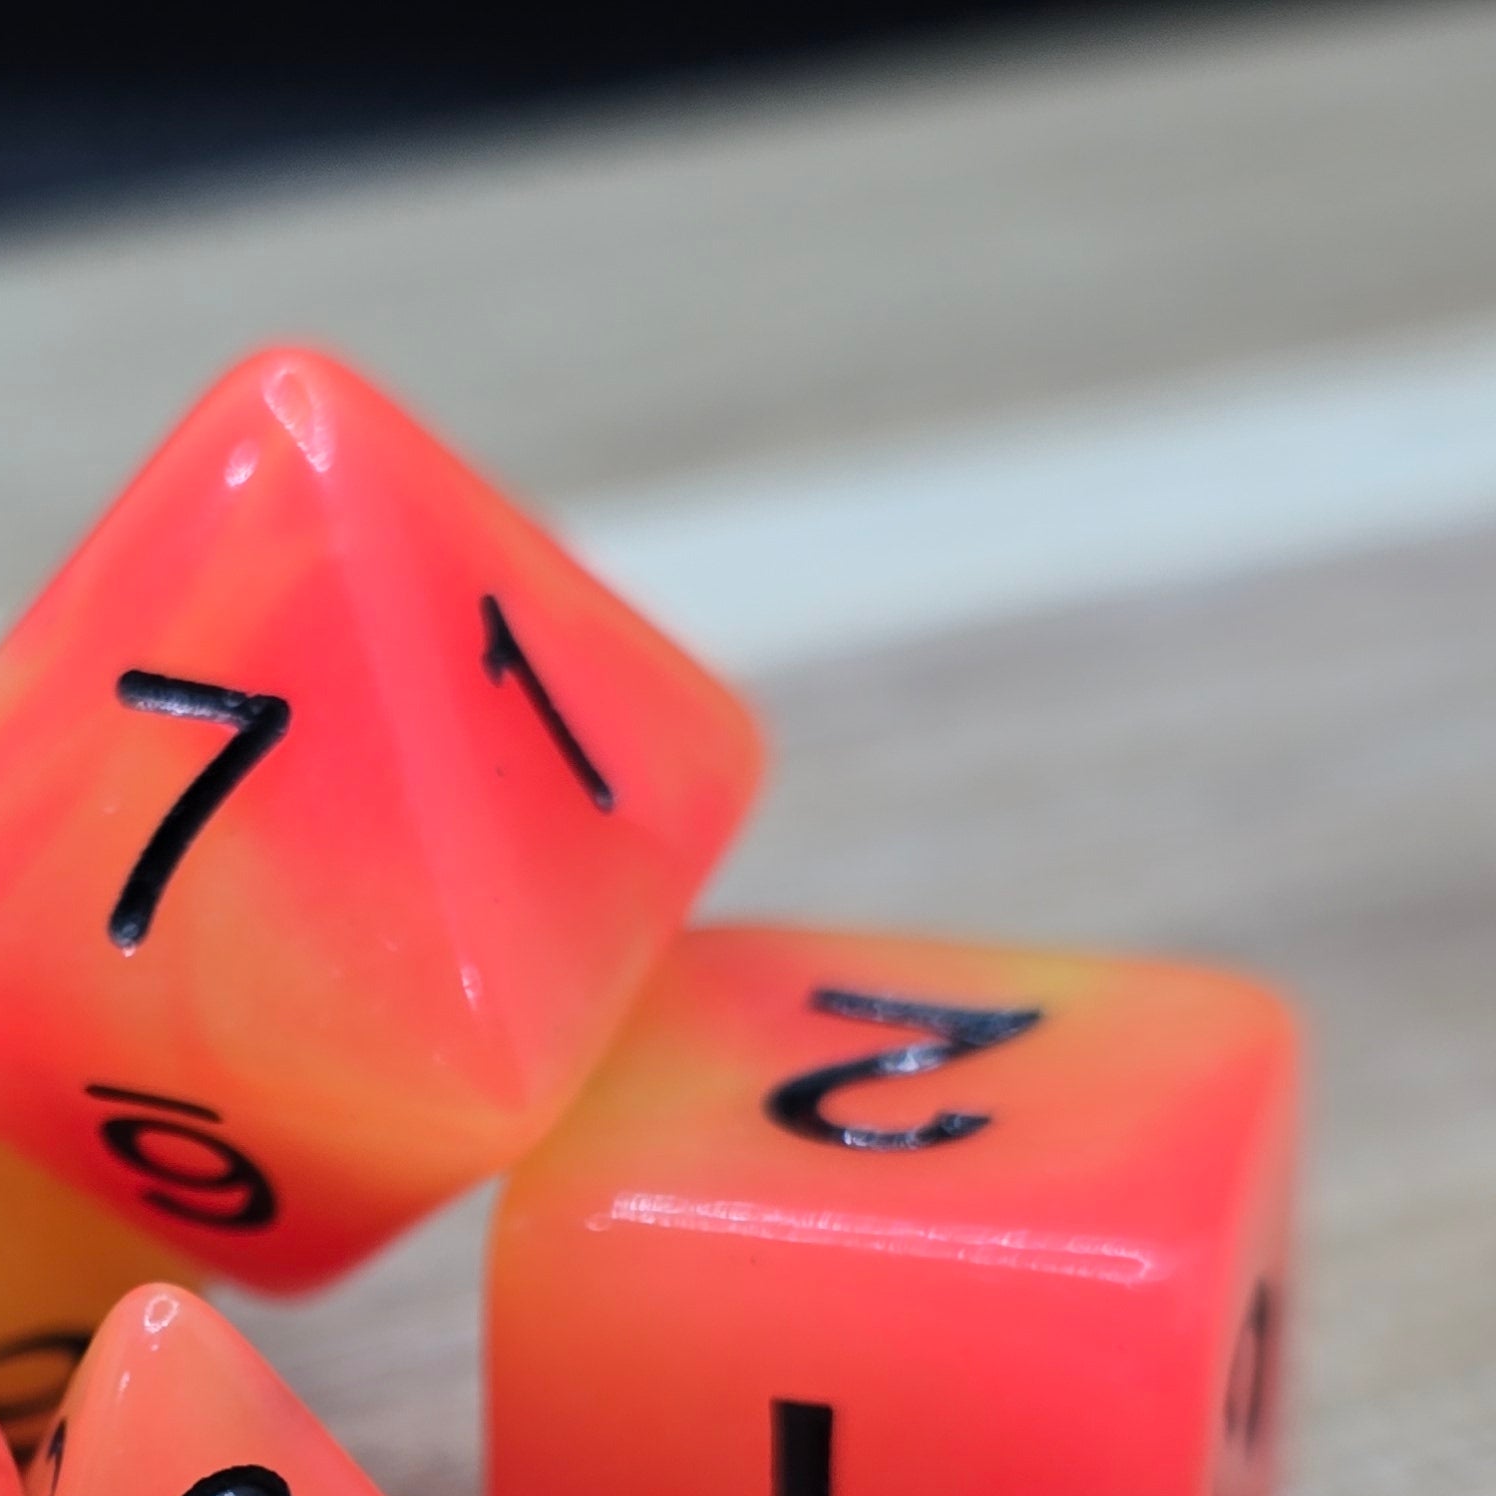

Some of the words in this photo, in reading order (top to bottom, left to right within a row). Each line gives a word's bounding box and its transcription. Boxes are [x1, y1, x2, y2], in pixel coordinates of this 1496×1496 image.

[108, 668, 291, 949] 7
[481, 593, 616, 815] 1
[762, 986, 1046, 1152] 2
